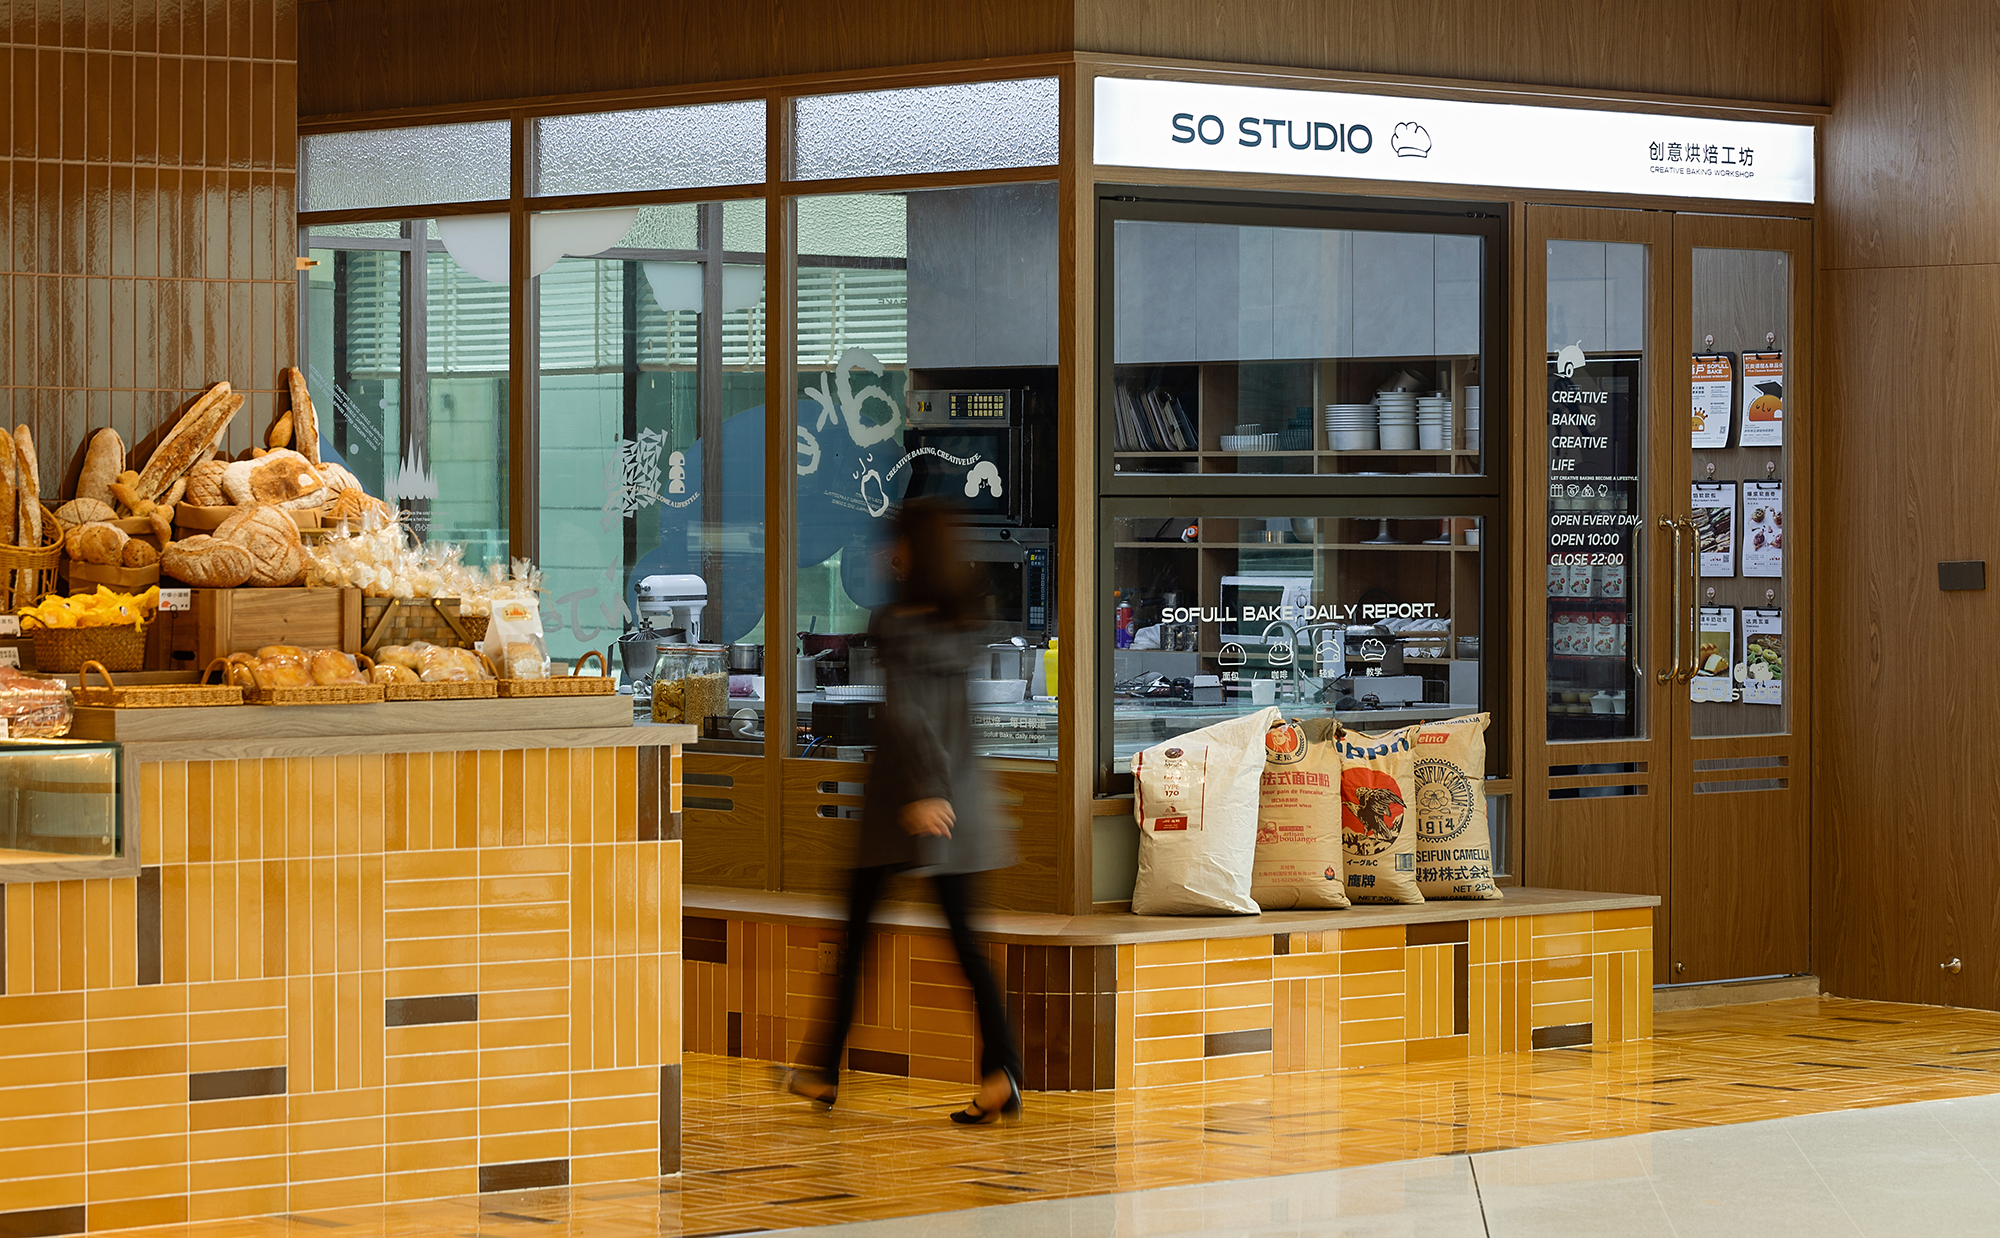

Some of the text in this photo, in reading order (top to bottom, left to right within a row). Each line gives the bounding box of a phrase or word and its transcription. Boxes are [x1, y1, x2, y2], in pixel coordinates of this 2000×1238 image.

[1171, 112, 1373, 154] SO STUDIO
[1648, 140, 1754, 166] 创意烘焙工坊
[1649, 165, 1755, 179] CREATIVE BAKING WORKSHOP
[1551, 390, 1608, 404] CREATIVE
[1551, 413, 1596, 426] BAKING
[1551, 436, 1608, 449] CREATIVE
[885, 446, 982, 482] CREATIVE BAKING, CREATIVE LIFE.
[1551, 458, 1576, 471] LIFE
[1551, 514, 1639, 526] OPEN EVERY DAY
[1551, 533, 1620, 546] OPEN 10:00
[1550, 553, 1624, 566] CLOSE 22:00
[1161, 602, 1439, 623] SOFULL BAKE, DAILY REPORT.
[1222, 671, 1240, 681] 面包
[1271, 669, 1288, 680] 咖啡
[1318, 668, 1336, 678] 轻食
[1366, 667, 1383, 677] 教学
[1692, 680, 1780, 703] SO STUDIO
[1015, 731, 1028, 740] daily
[1276, 788, 1290, 796] pain
[1414, 765, 1447, 786] SEIFUN
[1442, 771, 1468, 807] CAMELLIA
[1165, 790, 1180, 798] 170
[1418, 818, 1455, 835] 1914
[1279, 835, 1317, 844] boulanger
[1416, 848, 1490, 862] SEIFUN CAMELLIA
[1346, 858, 1379, 867] イーグルC
[1453, 885, 1472, 893] NET
